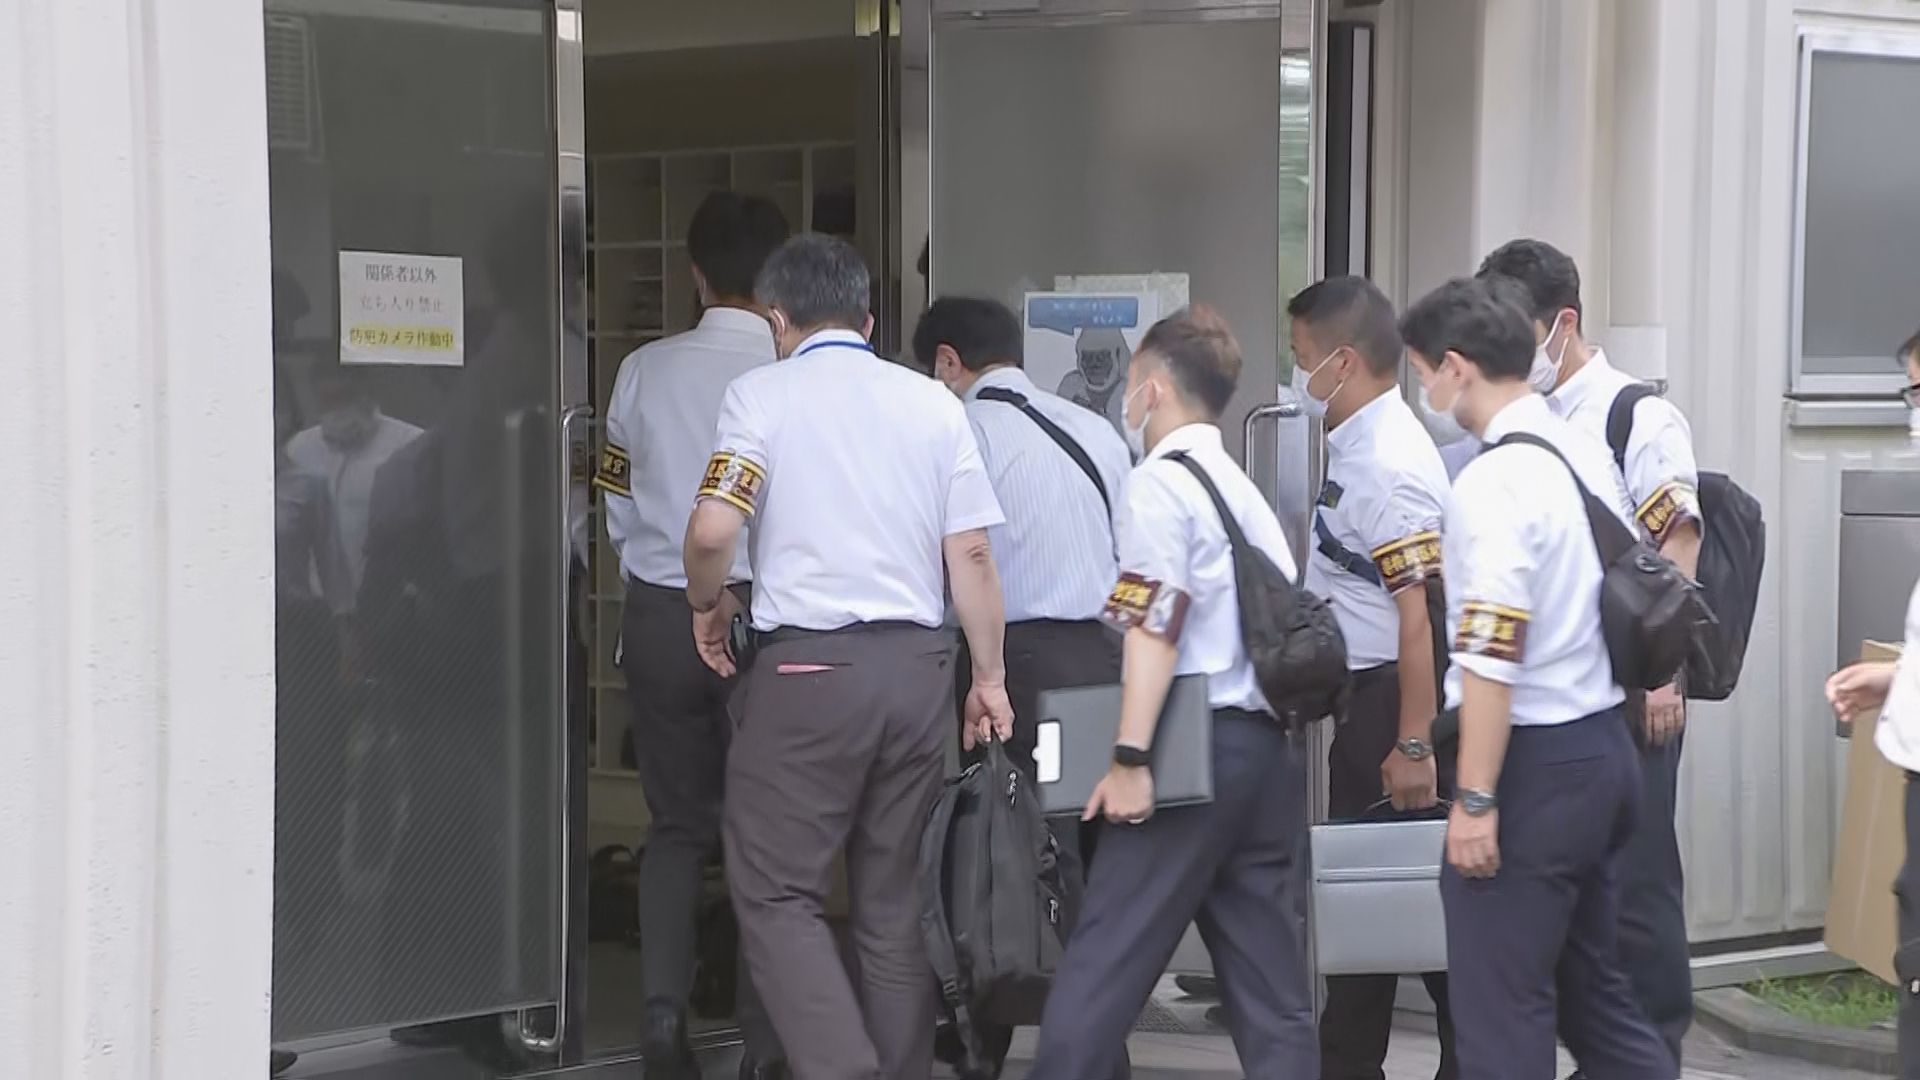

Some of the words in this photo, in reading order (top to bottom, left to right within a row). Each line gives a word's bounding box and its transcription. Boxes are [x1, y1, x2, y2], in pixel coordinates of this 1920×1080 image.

[365, 264, 437, 284] 関係者以外
[361, 294, 443, 313] 立ち入り禁止
[351, 328, 454, 348] 防犯カメラ作動中
